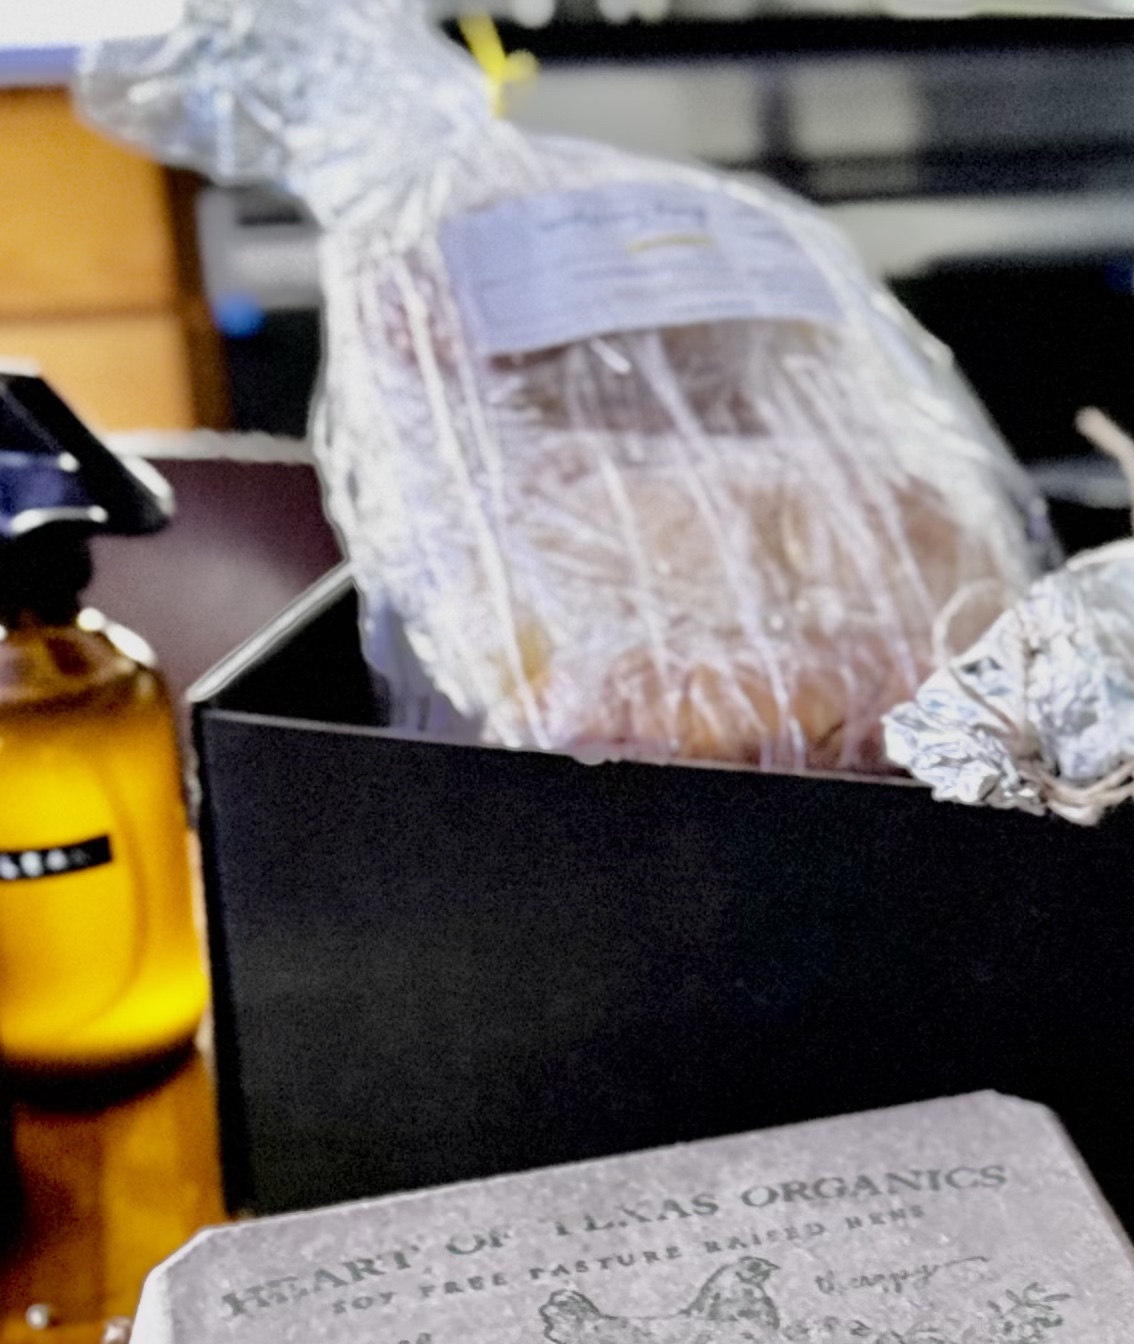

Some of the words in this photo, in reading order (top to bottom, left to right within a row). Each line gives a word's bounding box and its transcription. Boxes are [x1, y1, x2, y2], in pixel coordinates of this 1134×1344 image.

[221, 1244, 420, 1319] HEART
[741, 1165, 1008, 1210] ORGANICS
[331, 1290, 397, 1315] SOY
[418, 1271, 509, 1299] FREE
[529, 1242, 683, 1282] PASTURE
[703, 1221, 827, 1255] RAISED
[845, 1202, 927, 1231] HENS
